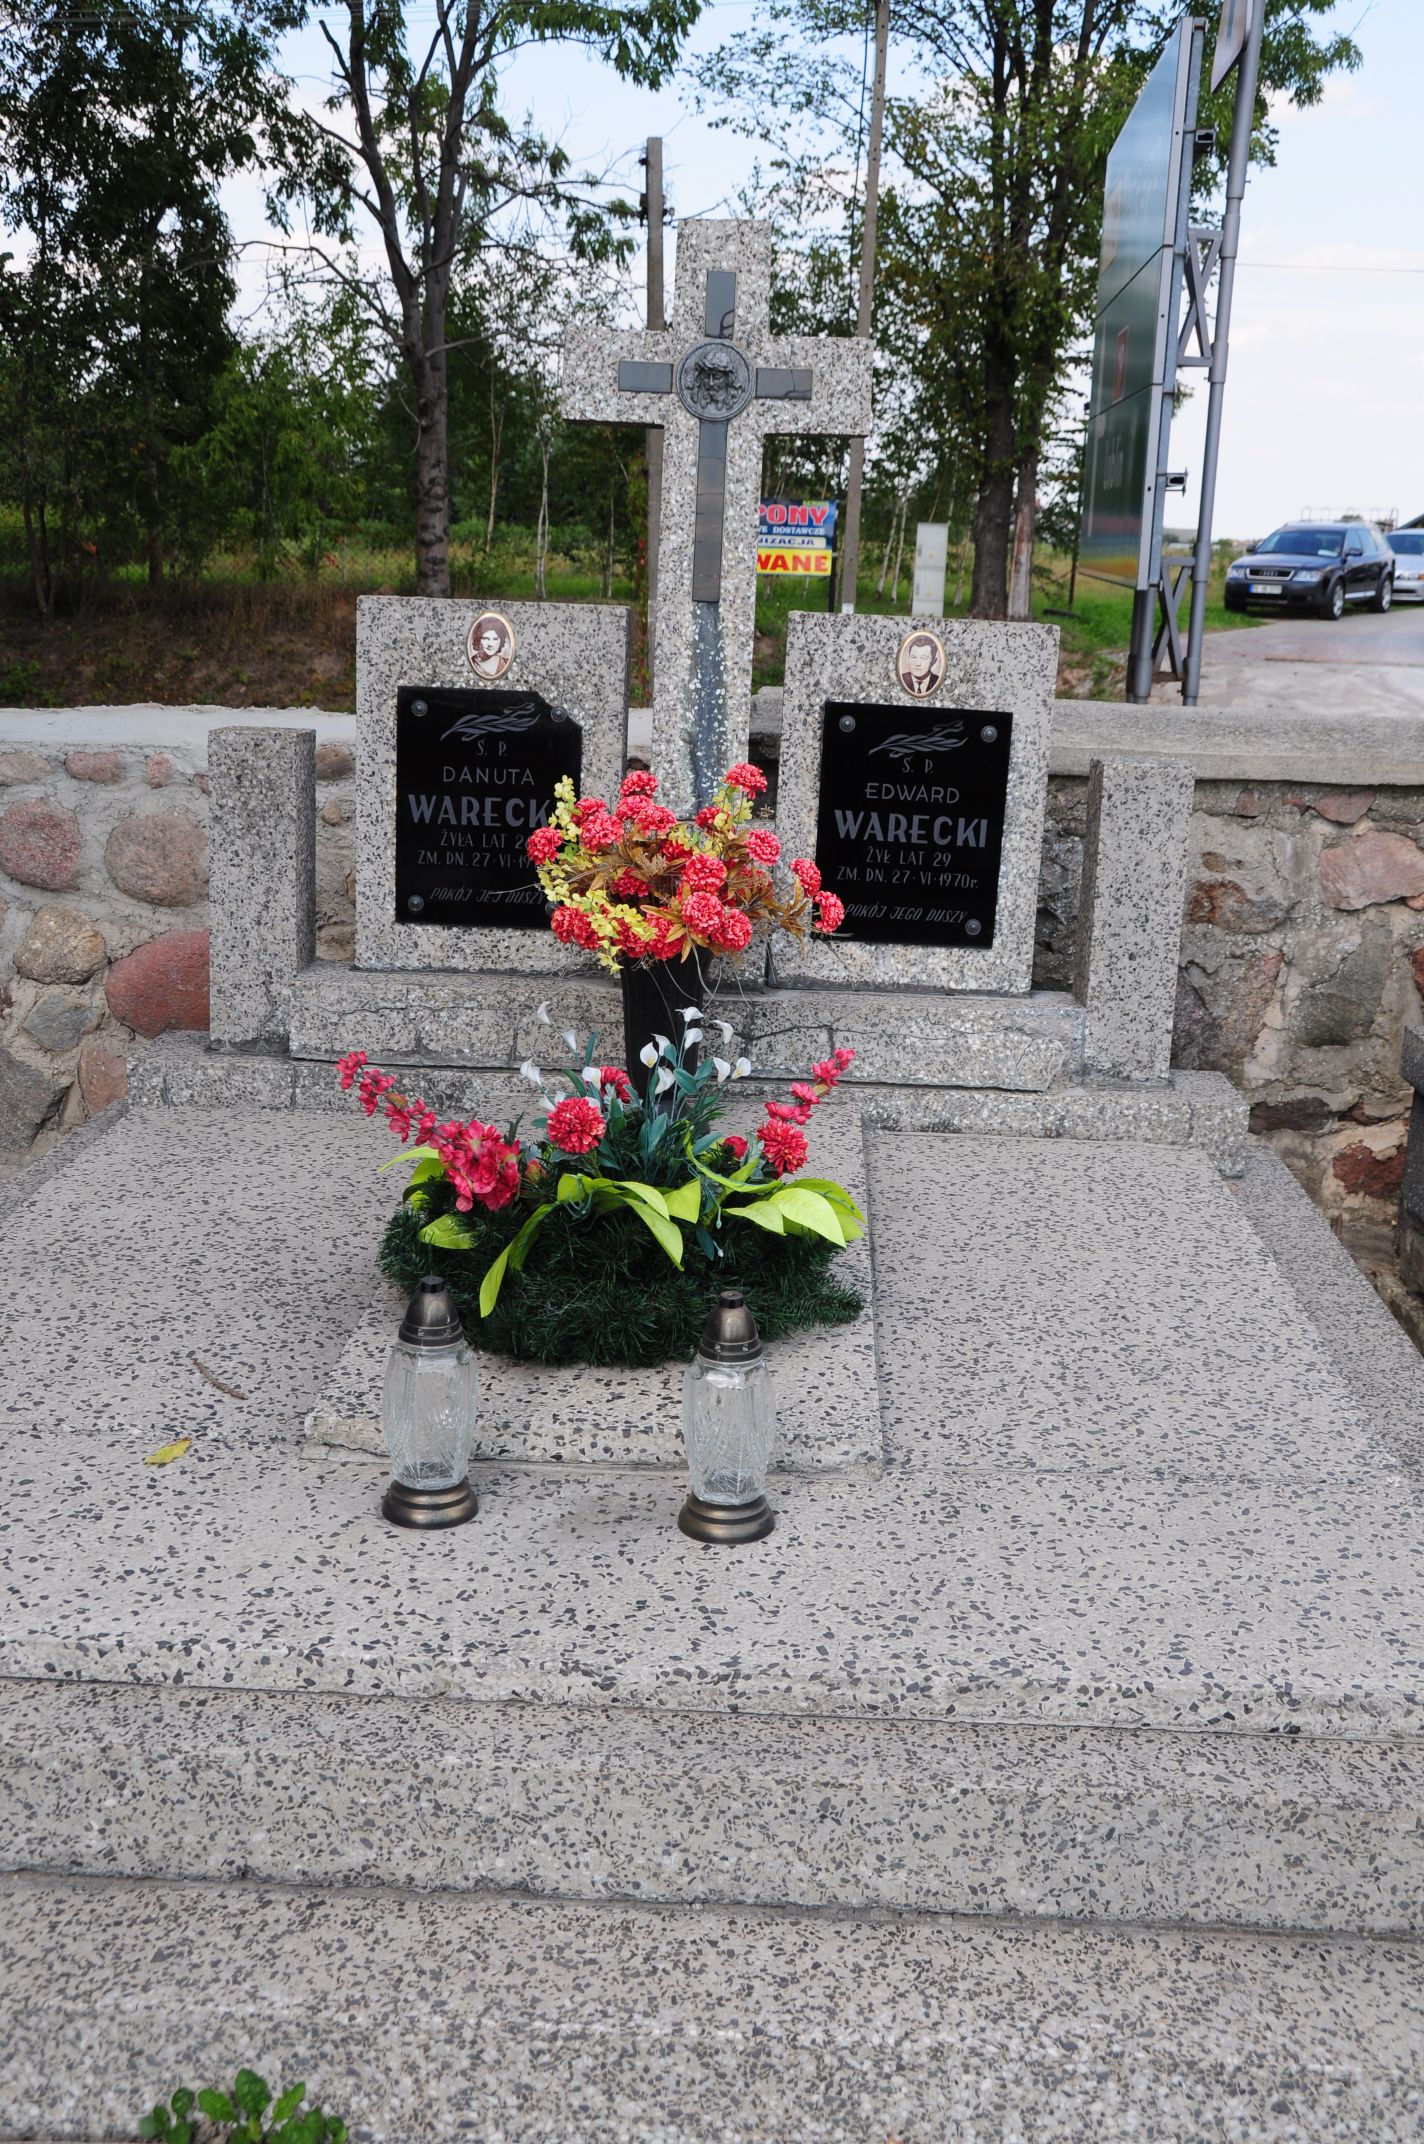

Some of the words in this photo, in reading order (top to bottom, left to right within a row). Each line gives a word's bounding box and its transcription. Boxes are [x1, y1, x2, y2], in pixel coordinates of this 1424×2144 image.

[442, 765, 536, 786] DANUTA
[865, 782, 960, 804] EDWARD
[407, 793, 551, 829] WARECK
[833, 809, 988, 848] WARECKI
[482, 833, 508, 849] LAT
[417, 849, 442, 866] ZM.
[446, 852, 469, 867] DN.
[899, 850, 926, 866] LAT
[932, 852, 952, 868] 29
[836, 866, 861, 881] ZM.
[865, 868, 888, 884] DN.
[429, 884, 472, 902] POKÓJ
[845, 901, 887, 919] POKÓJ
[890, 906, 923, 921] JEGO
[926, 909, 968, 924] DUSZY
